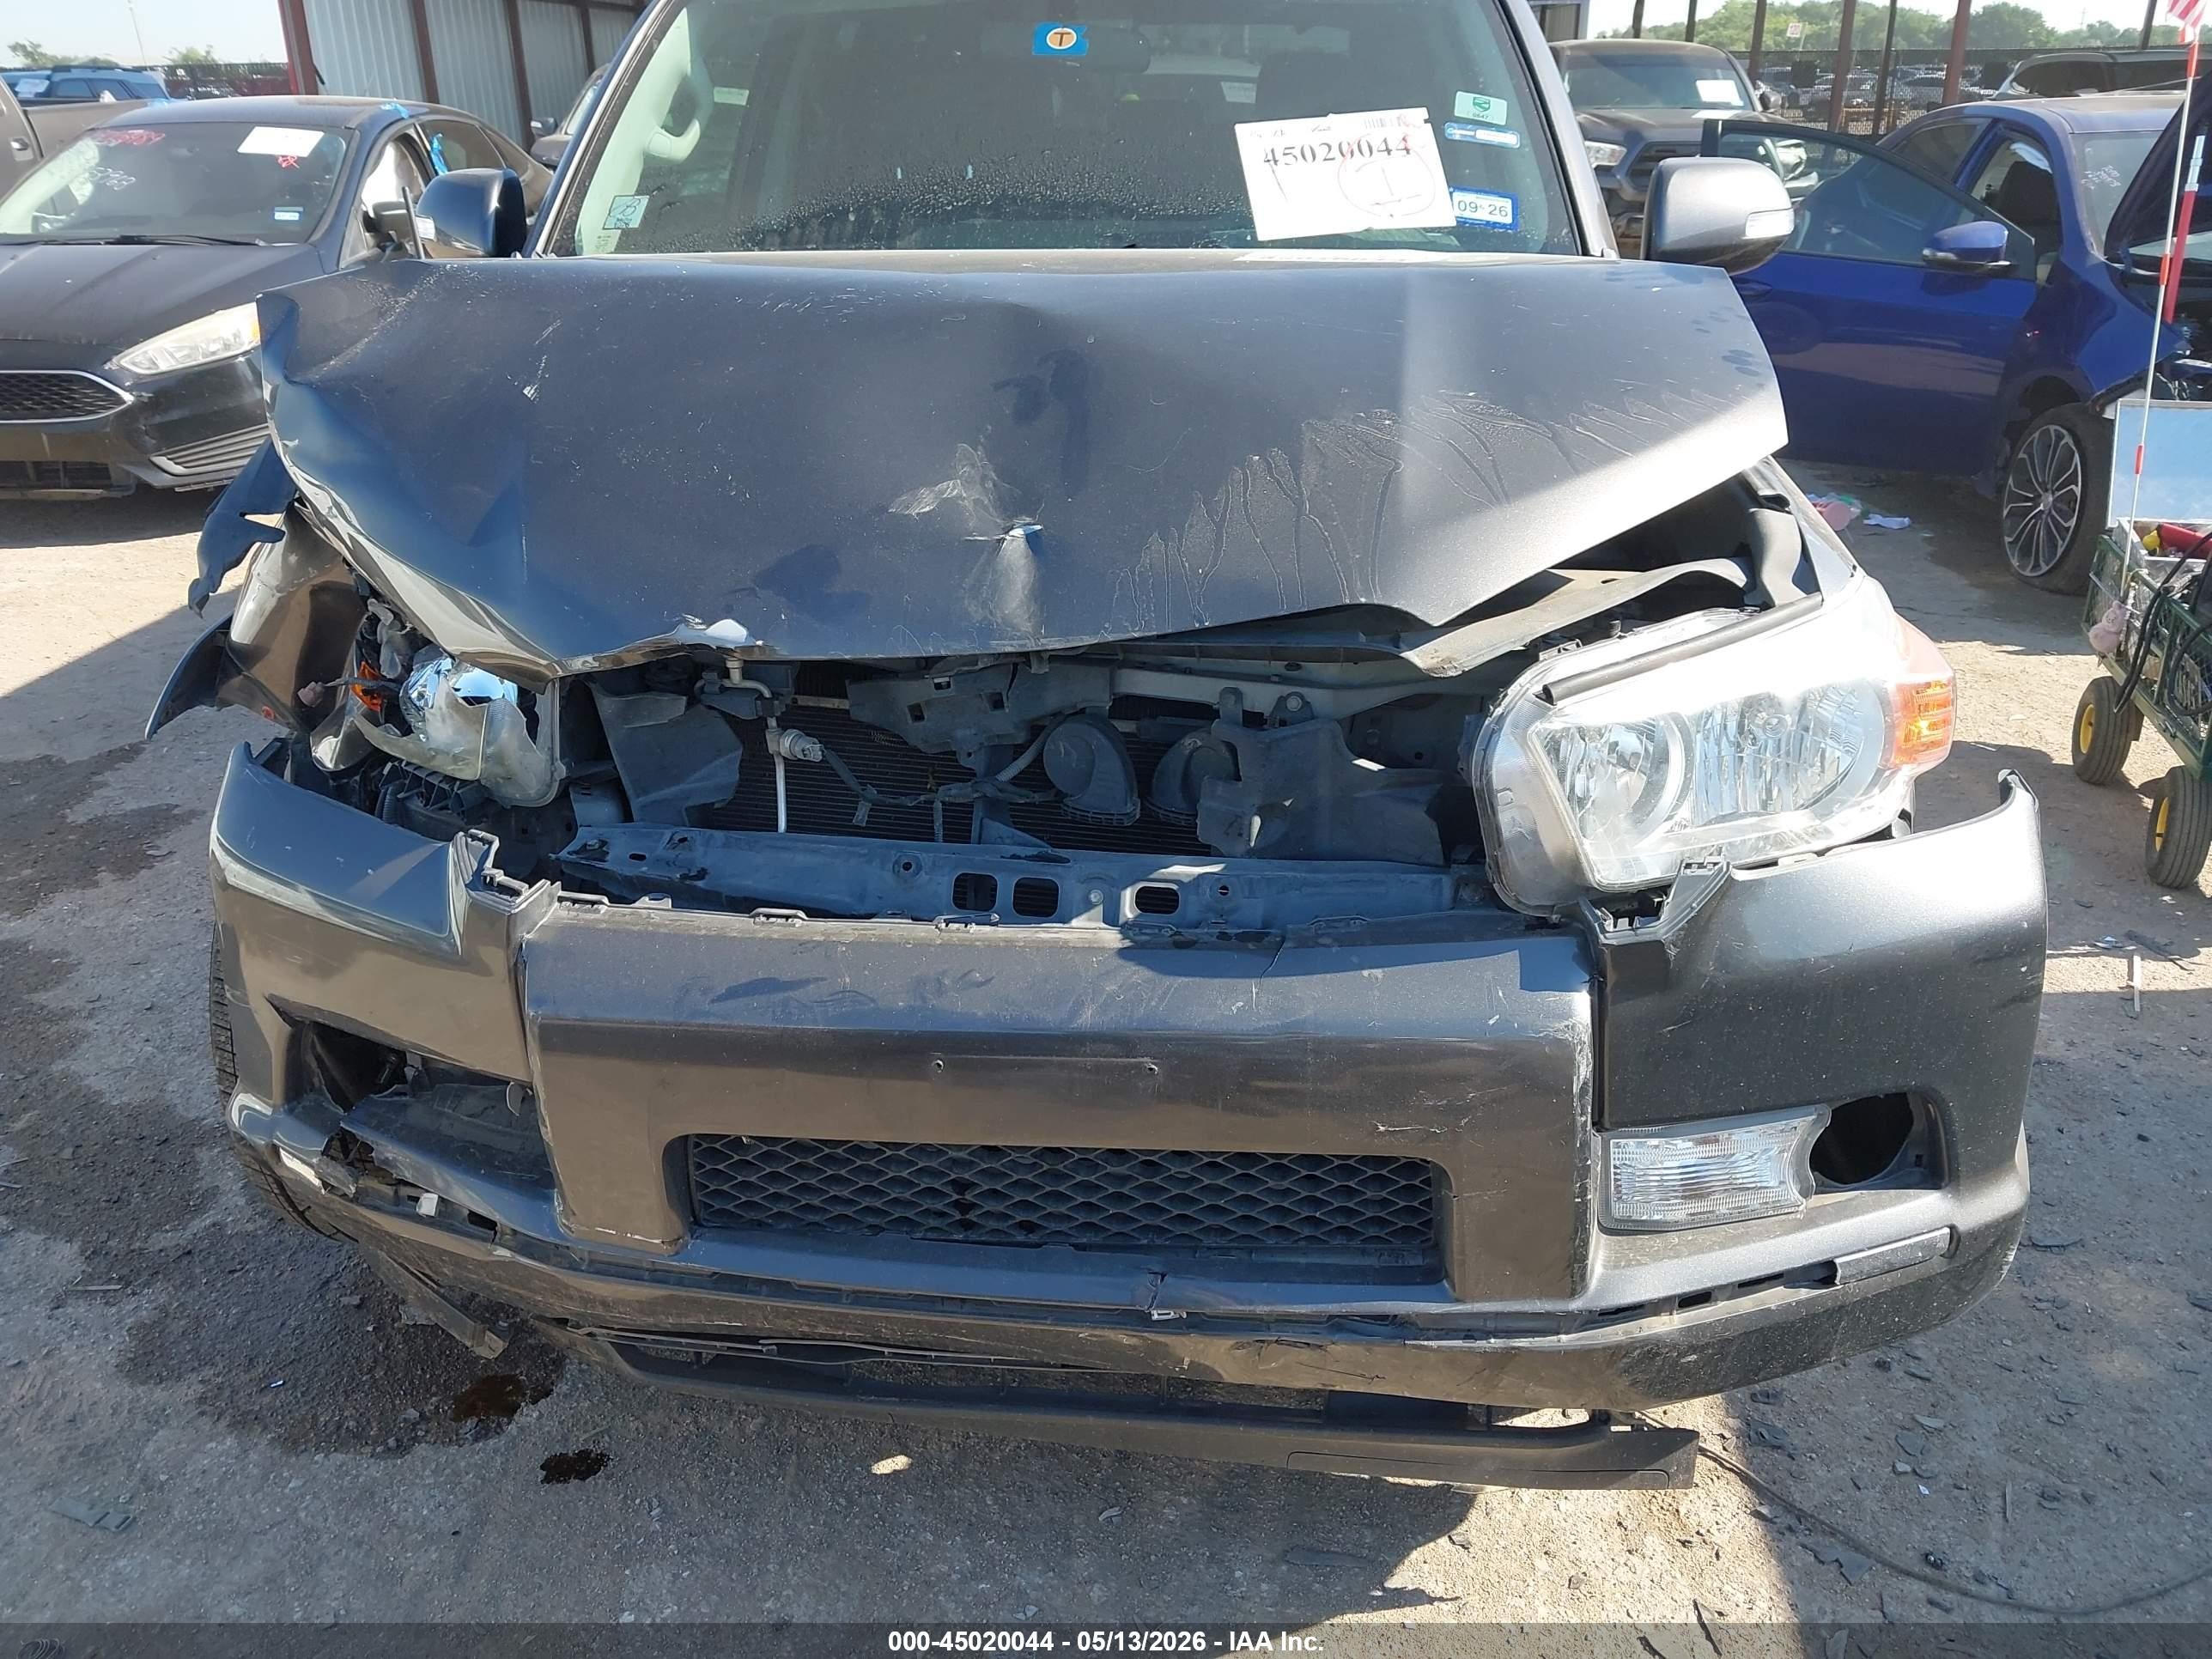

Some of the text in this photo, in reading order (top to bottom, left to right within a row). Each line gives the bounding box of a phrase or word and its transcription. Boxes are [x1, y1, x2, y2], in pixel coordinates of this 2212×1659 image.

[1053, 32, 1073, 47] T
[1263, 133, 1411, 166] 45020044
[1457, 199, 1478, 214] 09
[1487, 204, 1509, 218] 26
